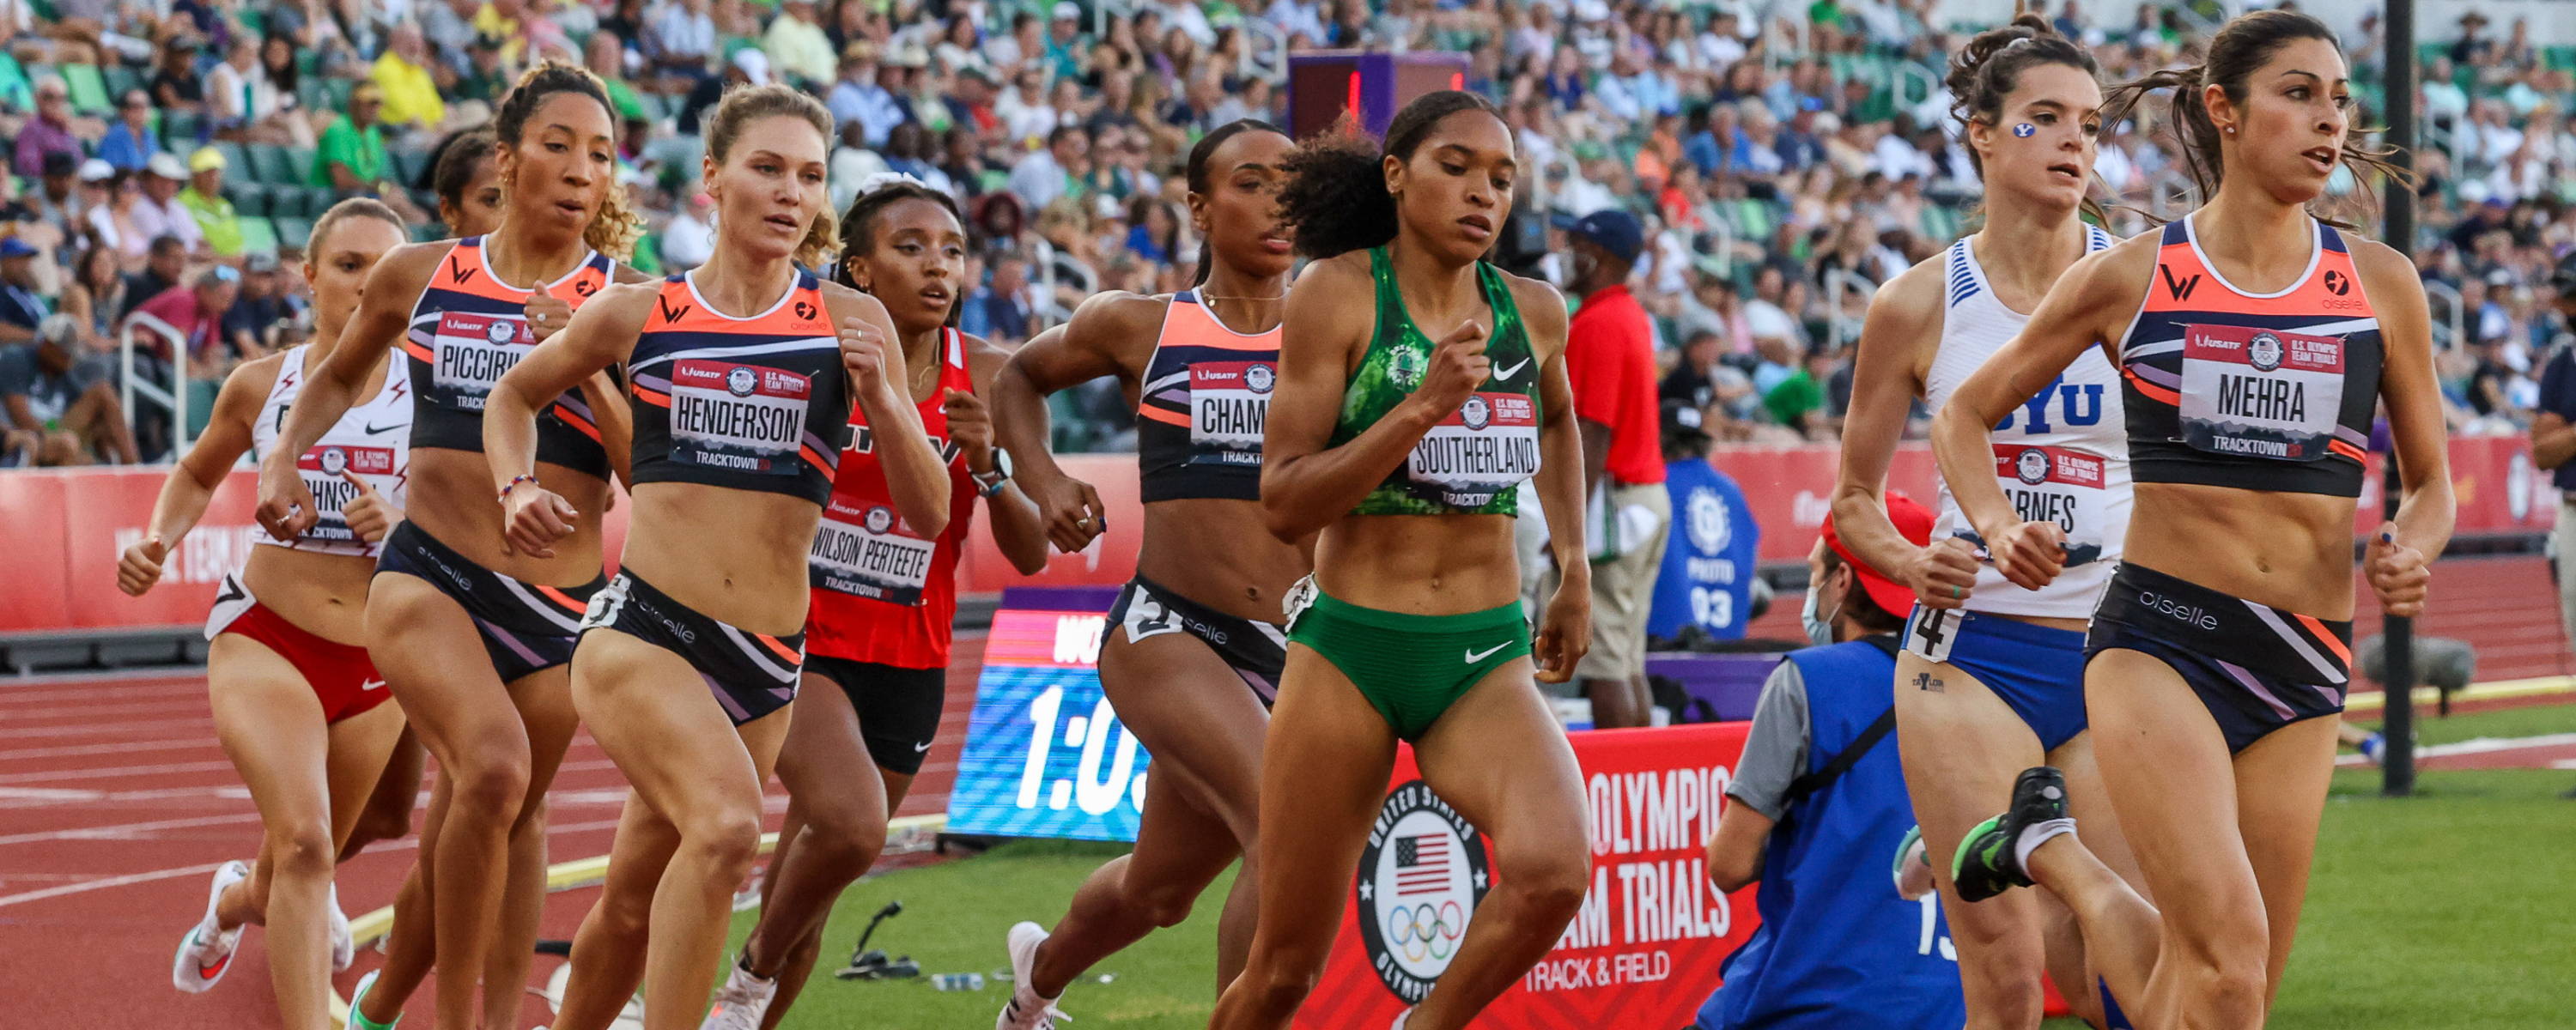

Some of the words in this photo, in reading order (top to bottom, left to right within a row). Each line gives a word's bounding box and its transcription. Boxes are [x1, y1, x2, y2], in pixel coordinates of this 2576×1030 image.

[2291, 350, 2312, 362] TEAM
[2312, 352, 2337, 365] TRIALS
[2306, 341, 2338, 355] OLYMPIC
[677, 396, 800, 443] HENDERSON
[1202, 398, 1267, 434] CHAM
[2218, 374, 2306, 423] MEHRA
[1417, 436, 1535, 475] SOUTHERLAND
[811, 526, 864, 566] WILSON
[862, 538, 928, 579] PERTEETE
[1137, 593, 1171, 635] 2
[1916, 608, 1945, 657] 4
[2139, 591, 2218, 630] oiselle
[1369, 785, 1418, 849] UNITED
[1589, 765, 1732, 857] OLYMPIC
[1552, 864, 1611, 951] AM
[1618, 857, 1732, 944] TRIALS
[1525, 957, 1592, 993] TRACK
[1595, 956, 1611, 987] &
[1614, 950, 1671, 985] FIELD
